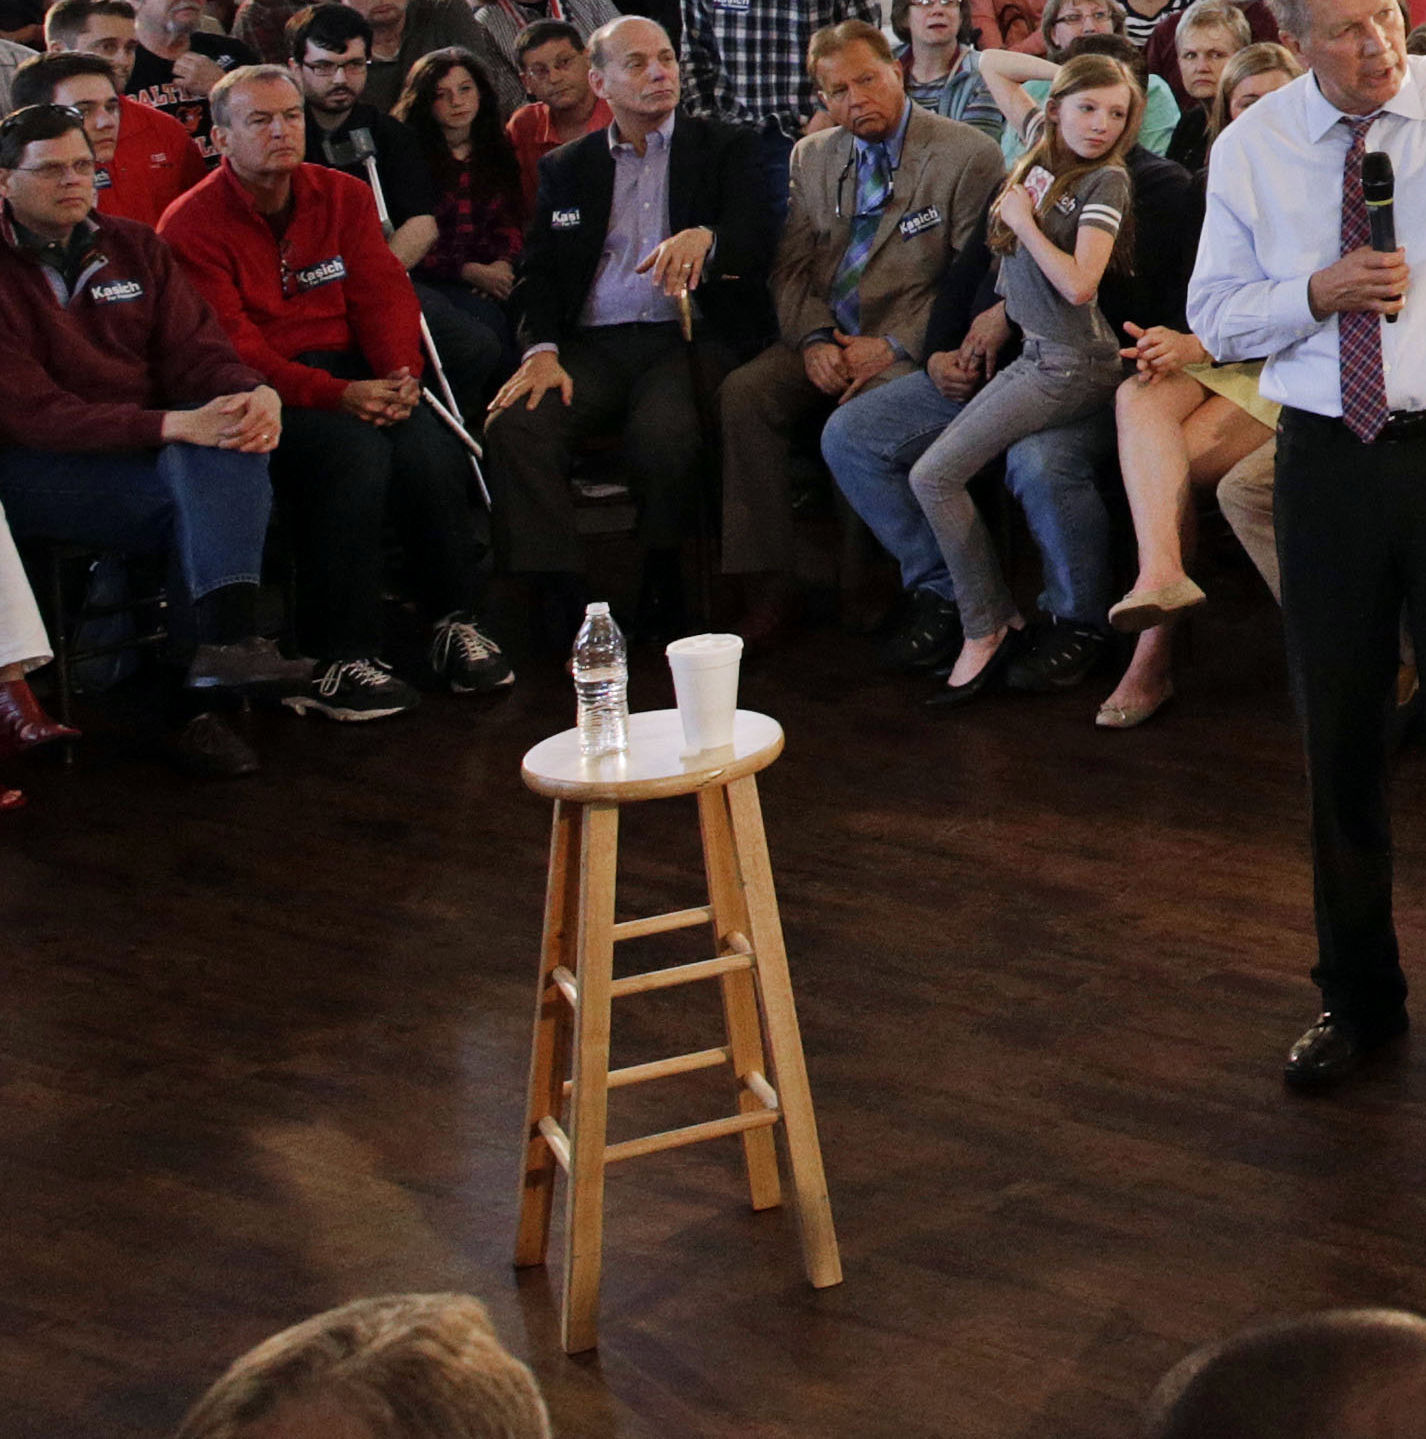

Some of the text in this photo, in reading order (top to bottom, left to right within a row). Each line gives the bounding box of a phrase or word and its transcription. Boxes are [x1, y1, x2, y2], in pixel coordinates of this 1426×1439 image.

[552, 210, 581, 223] Kasi
[900, 205, 940, 234] Kasich
[91, 281, 142, 300] Kasich
